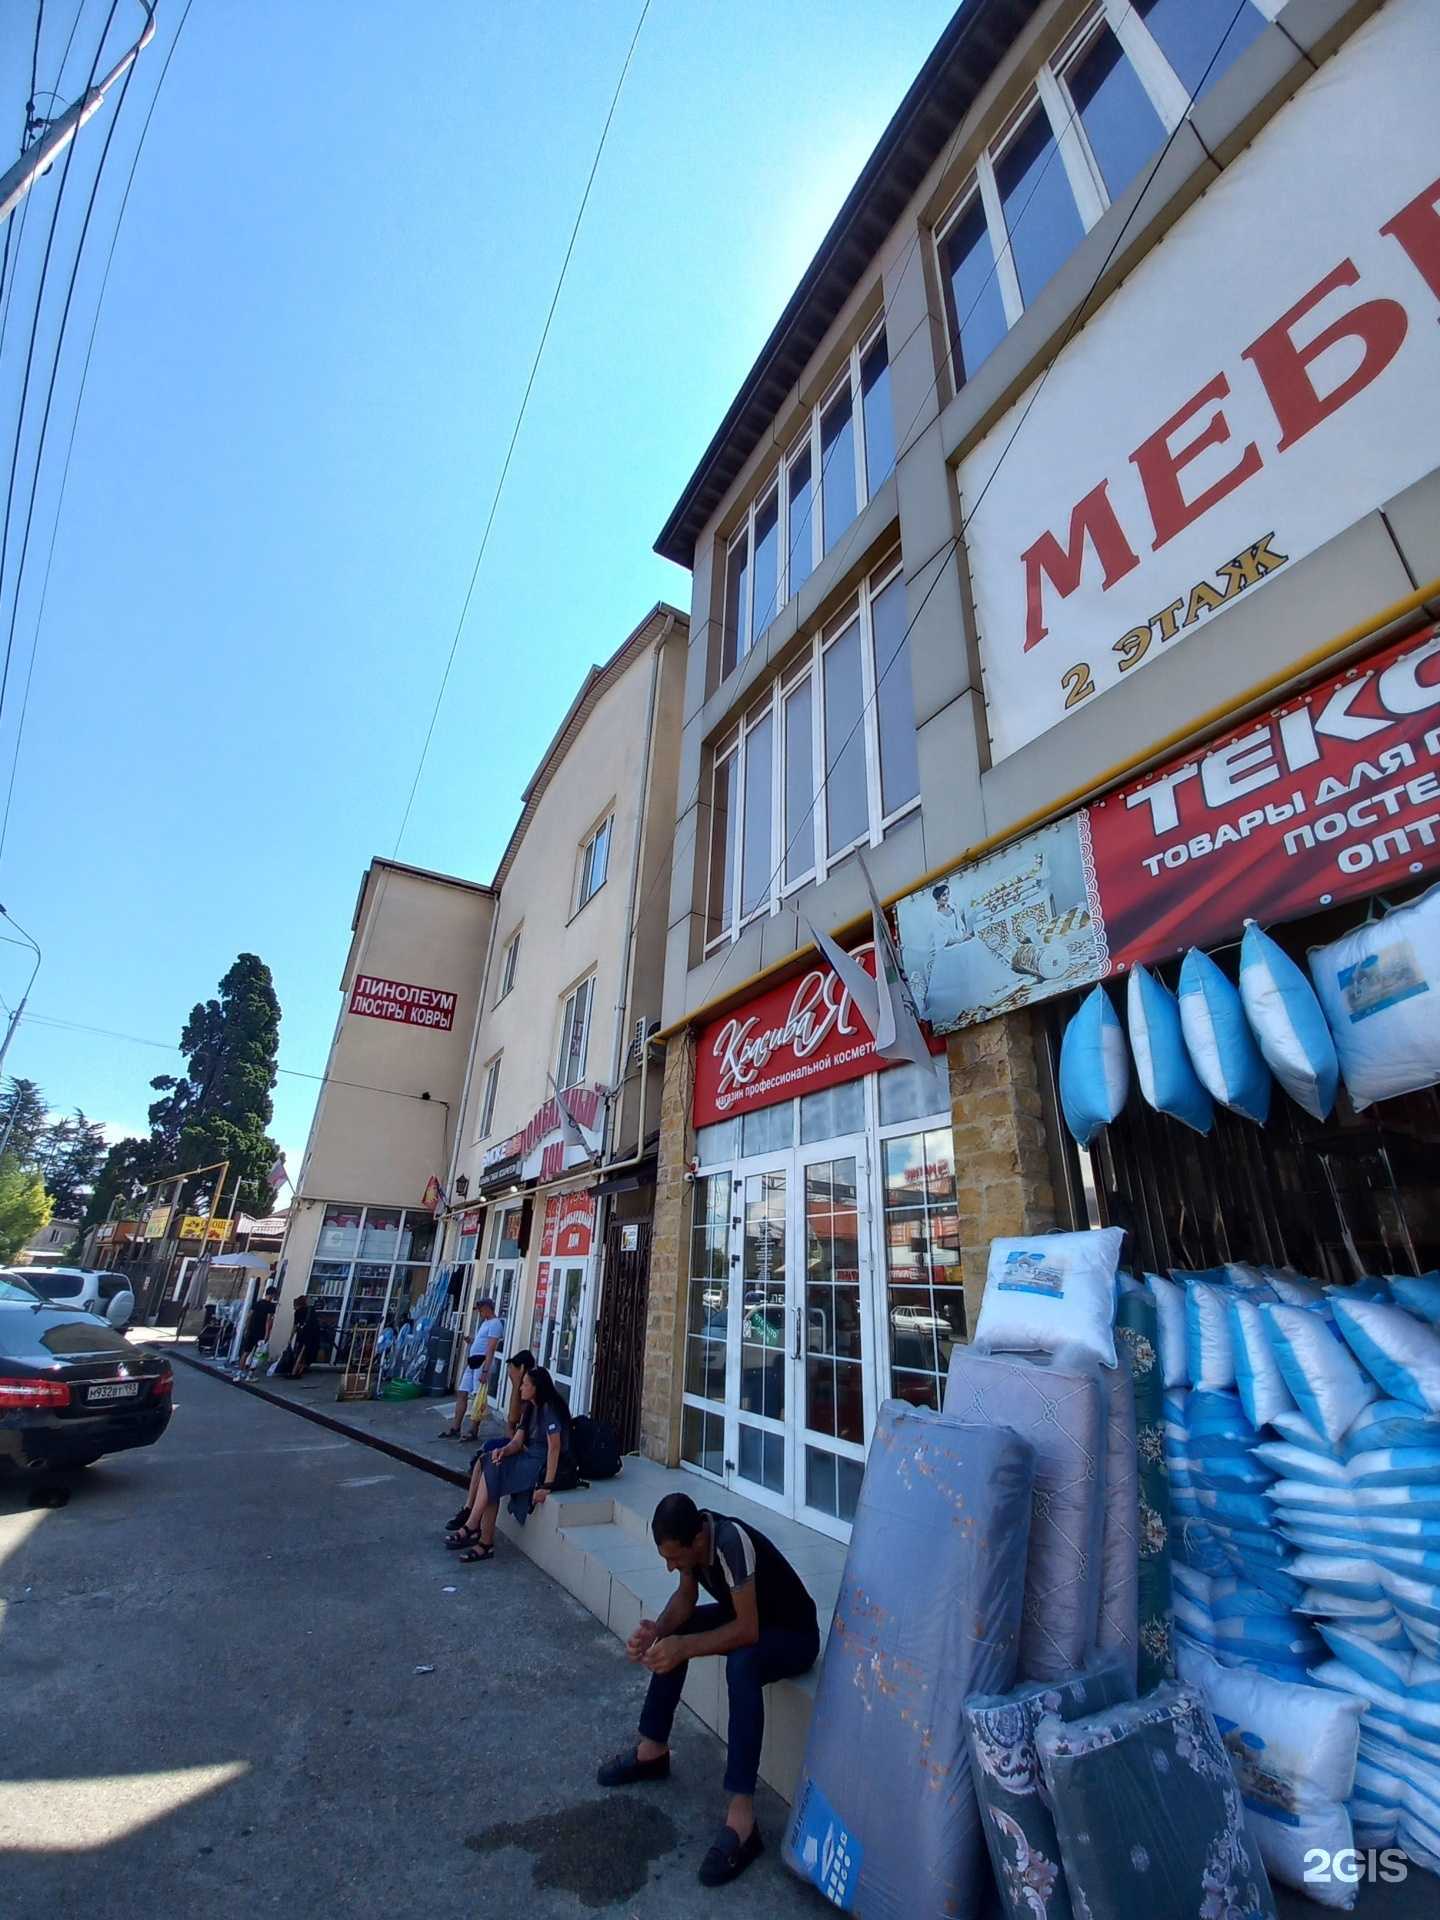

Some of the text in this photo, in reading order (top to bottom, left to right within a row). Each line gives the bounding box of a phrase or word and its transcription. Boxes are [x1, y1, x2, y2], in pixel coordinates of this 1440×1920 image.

[1061, 531, 1288, 710] 2 ЭТАЖ
[1142, 742, 1416, 877] ТОВАРЫ ДЛЯ
[1282, 772, 1440, 857] ПОСТЕ
[352, 996, 451, 1029] ЛЮСТРЫ КОВРЫ
[357, 977, 454, 1011] ЛИНОЛЕУМ
[745, 1056, 832, 1098] профессиональной
